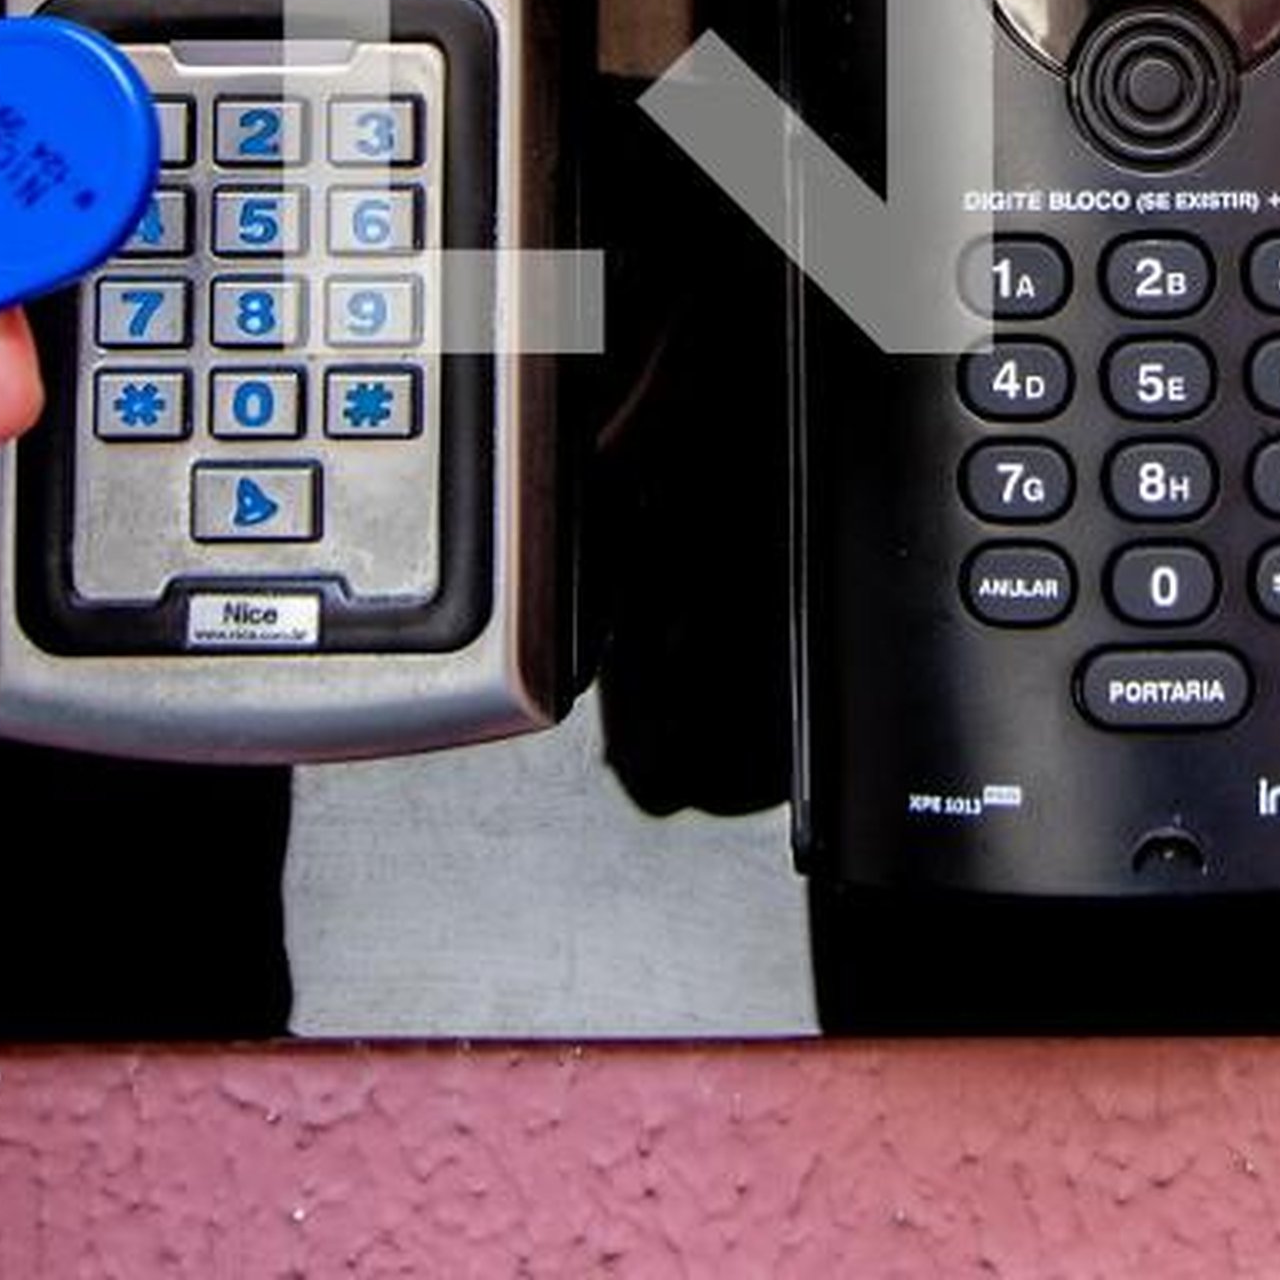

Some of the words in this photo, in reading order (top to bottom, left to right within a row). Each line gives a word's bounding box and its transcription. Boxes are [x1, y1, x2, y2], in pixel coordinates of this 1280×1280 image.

[238, 109, 282, 155] 2
[357, 113, 396, 155] 3
[963, 189, 1043, 212] DIGITE
[1048, 189, 1132, 212] BLOCO
[1136, 190, 1170, 214] (SE
[1175, 190, 1261, 213] EXISTIR)
[240, 200, 279, 245] 5
[352, 200, 392, 245] 6
[1134, 258, 1187, 297] 2B
[121, 291, 164, 336] 7
[236, 292, 276, 336] 8
[345, 292, 388, 335] 9
[992, 360, 1045, 400] 4D
[1137, 363, 1186, 403] 5E
[233, 381, 274, 427] 0
[997, 463, 1045, 503] 7G
[1138, 462, 1189, 501] 8H
[979, 577, 1058, 598] ANULAR
[1150, 566, 1178, 606] 0
[223, 601, 277, 625] Nice
[1109, 680, 1225, 704] PORTARIA
